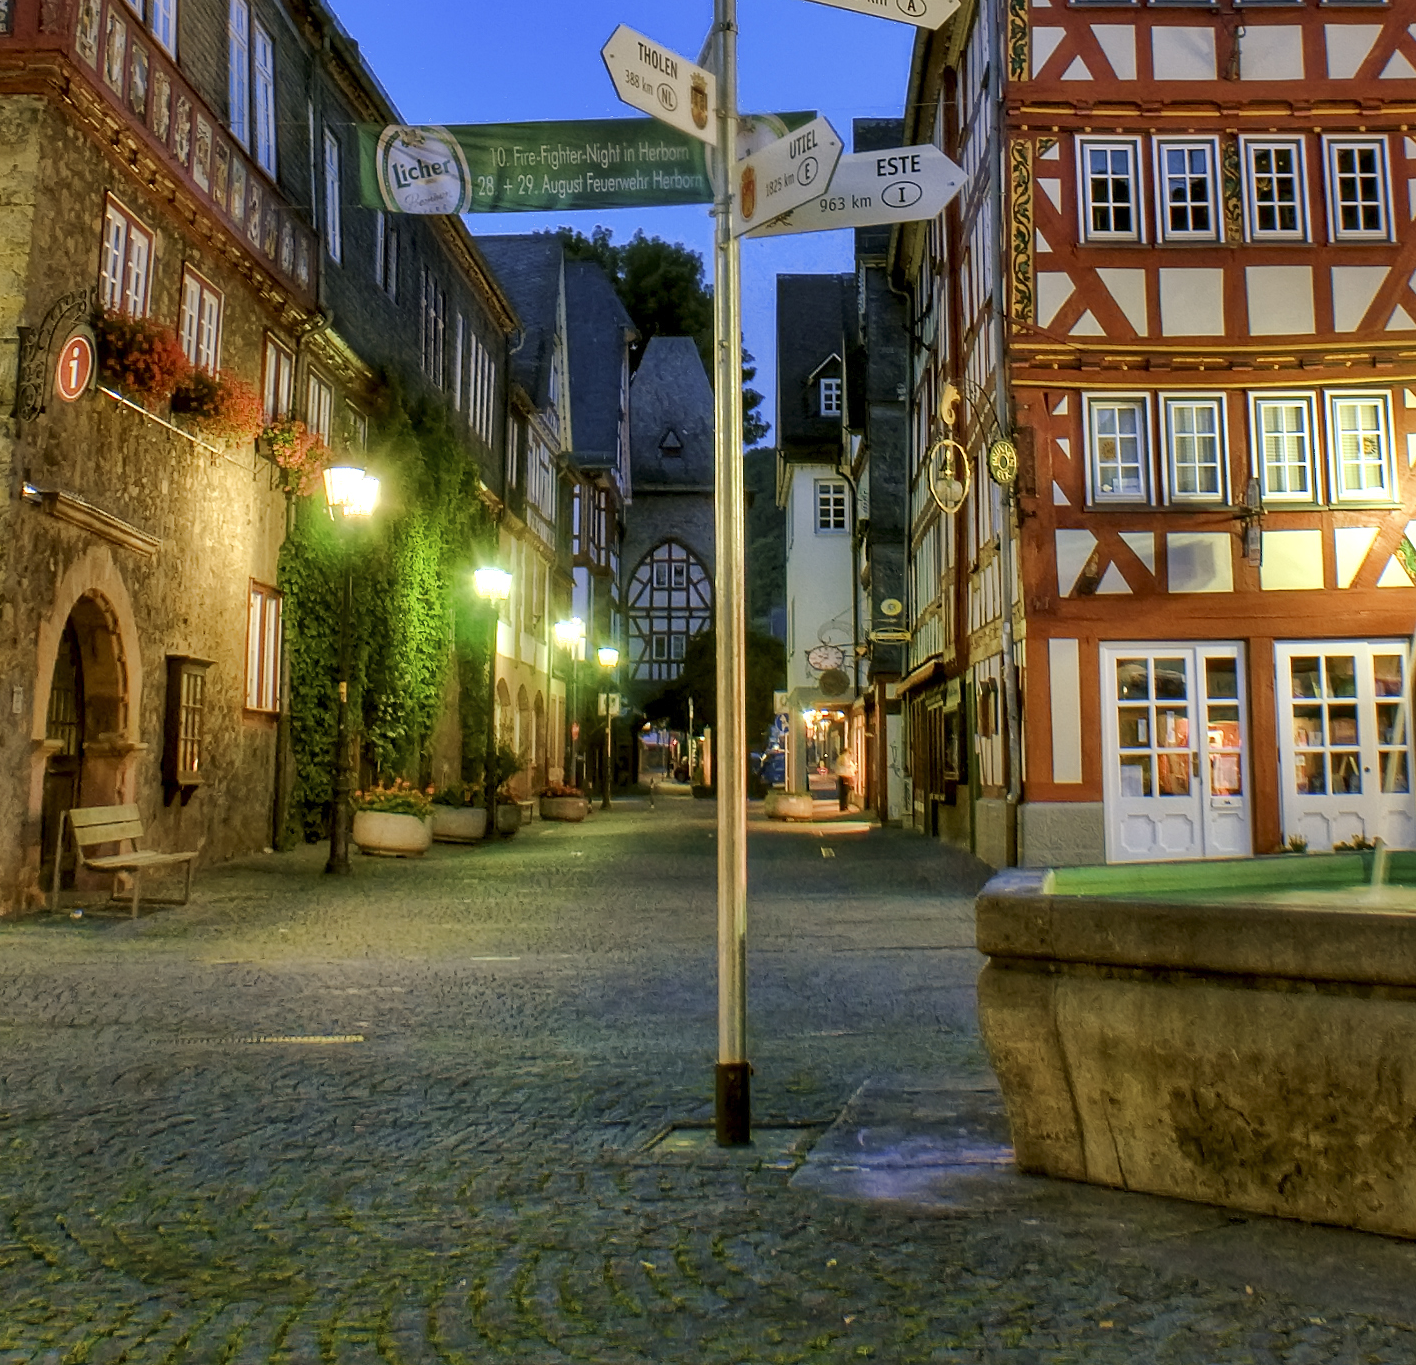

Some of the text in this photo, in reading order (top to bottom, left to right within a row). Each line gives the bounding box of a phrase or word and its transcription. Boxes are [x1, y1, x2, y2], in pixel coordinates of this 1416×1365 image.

[637, 41, 678, 80] THOLEN
[625, 69, 653, 95] 388 km
[662, 87, 673, 108] NL
[489, 141, 689, 170] 10. Fire-Fighter-Night in Herborn
[789, 129, 818, 159] UTIEL
[391, 159, 451, 189] Licher
[804, 163, 810, 180] E
[876, 154, 921, 177] ESTE
[477, 176, 499, 196] 28.
[517, 175, 538, 195] 29.
[541, 174, 584, 199] August
[586, 169, 649, 193] Feuerwehr
[652, 168, 703, 189] Herborn
[765, 172, 795, 198] 1825 km
[898, 187, 906, 202] I
[819, 194, 872, 213] 963 km
